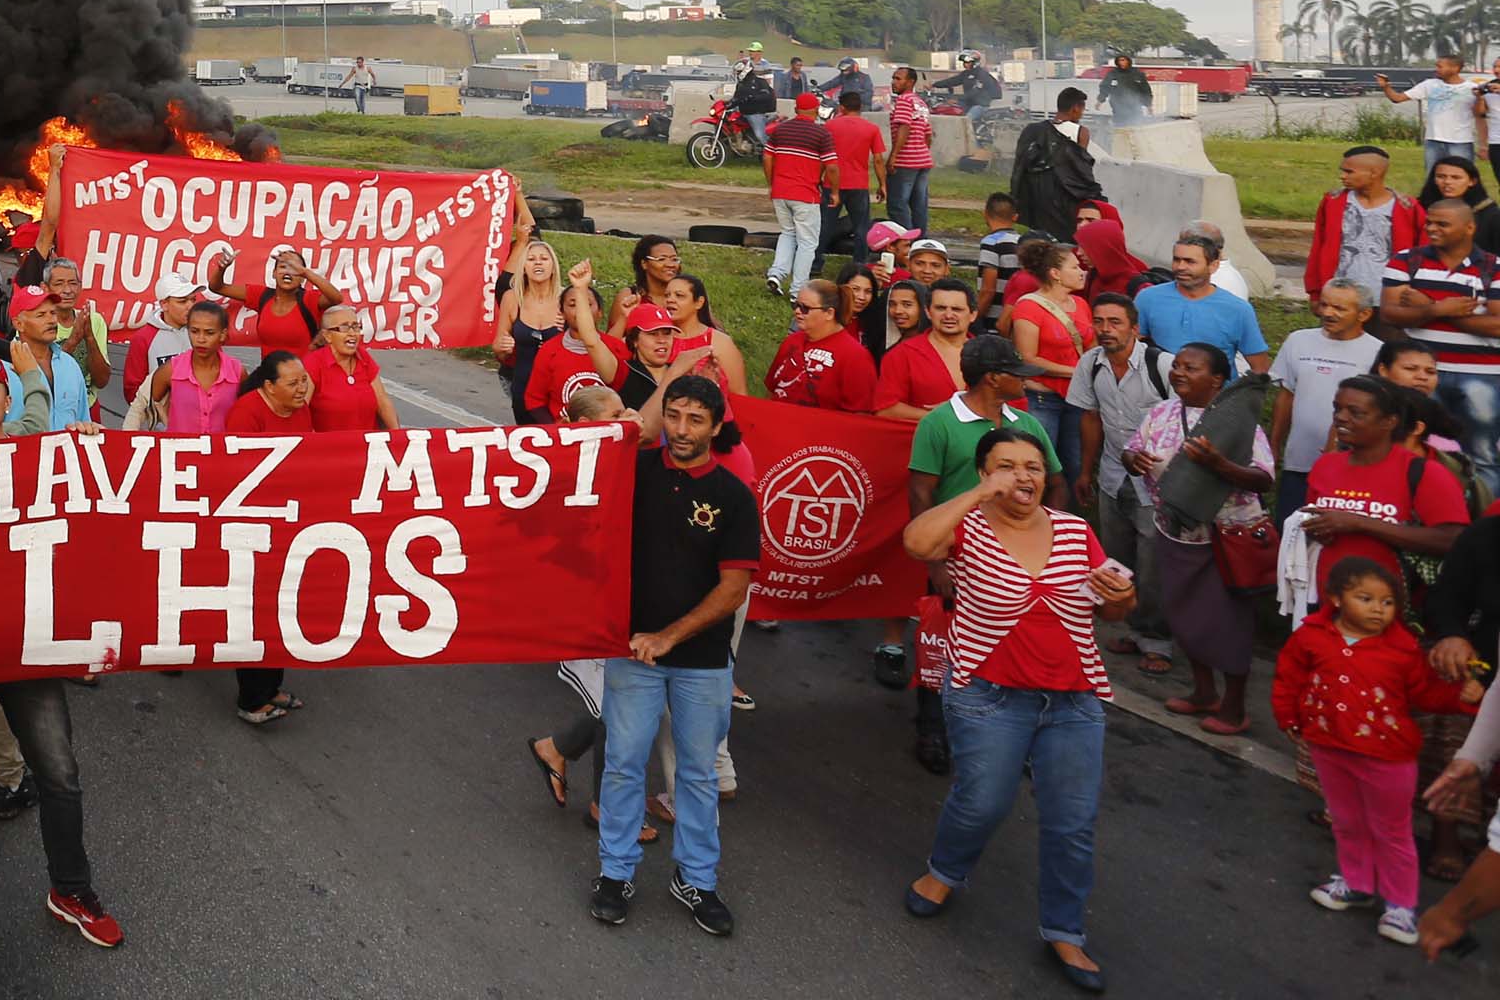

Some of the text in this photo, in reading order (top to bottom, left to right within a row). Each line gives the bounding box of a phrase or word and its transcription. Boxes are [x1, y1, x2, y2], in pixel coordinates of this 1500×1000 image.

[75, 160, 148, 208] MTST
[141, 173, 414, 246] OCUPAÇÃO
[415, 174, 490, 243] MTST
[82, 230, 237, 302] HUGO
[351, 424, 624, 514] MTST
[792, 447, 808, 461] DOS
[1369, 501, 1398, 516] DO
[783, 535, 835, 551] BRASIL
[767, 571, 825, 586] MTST
